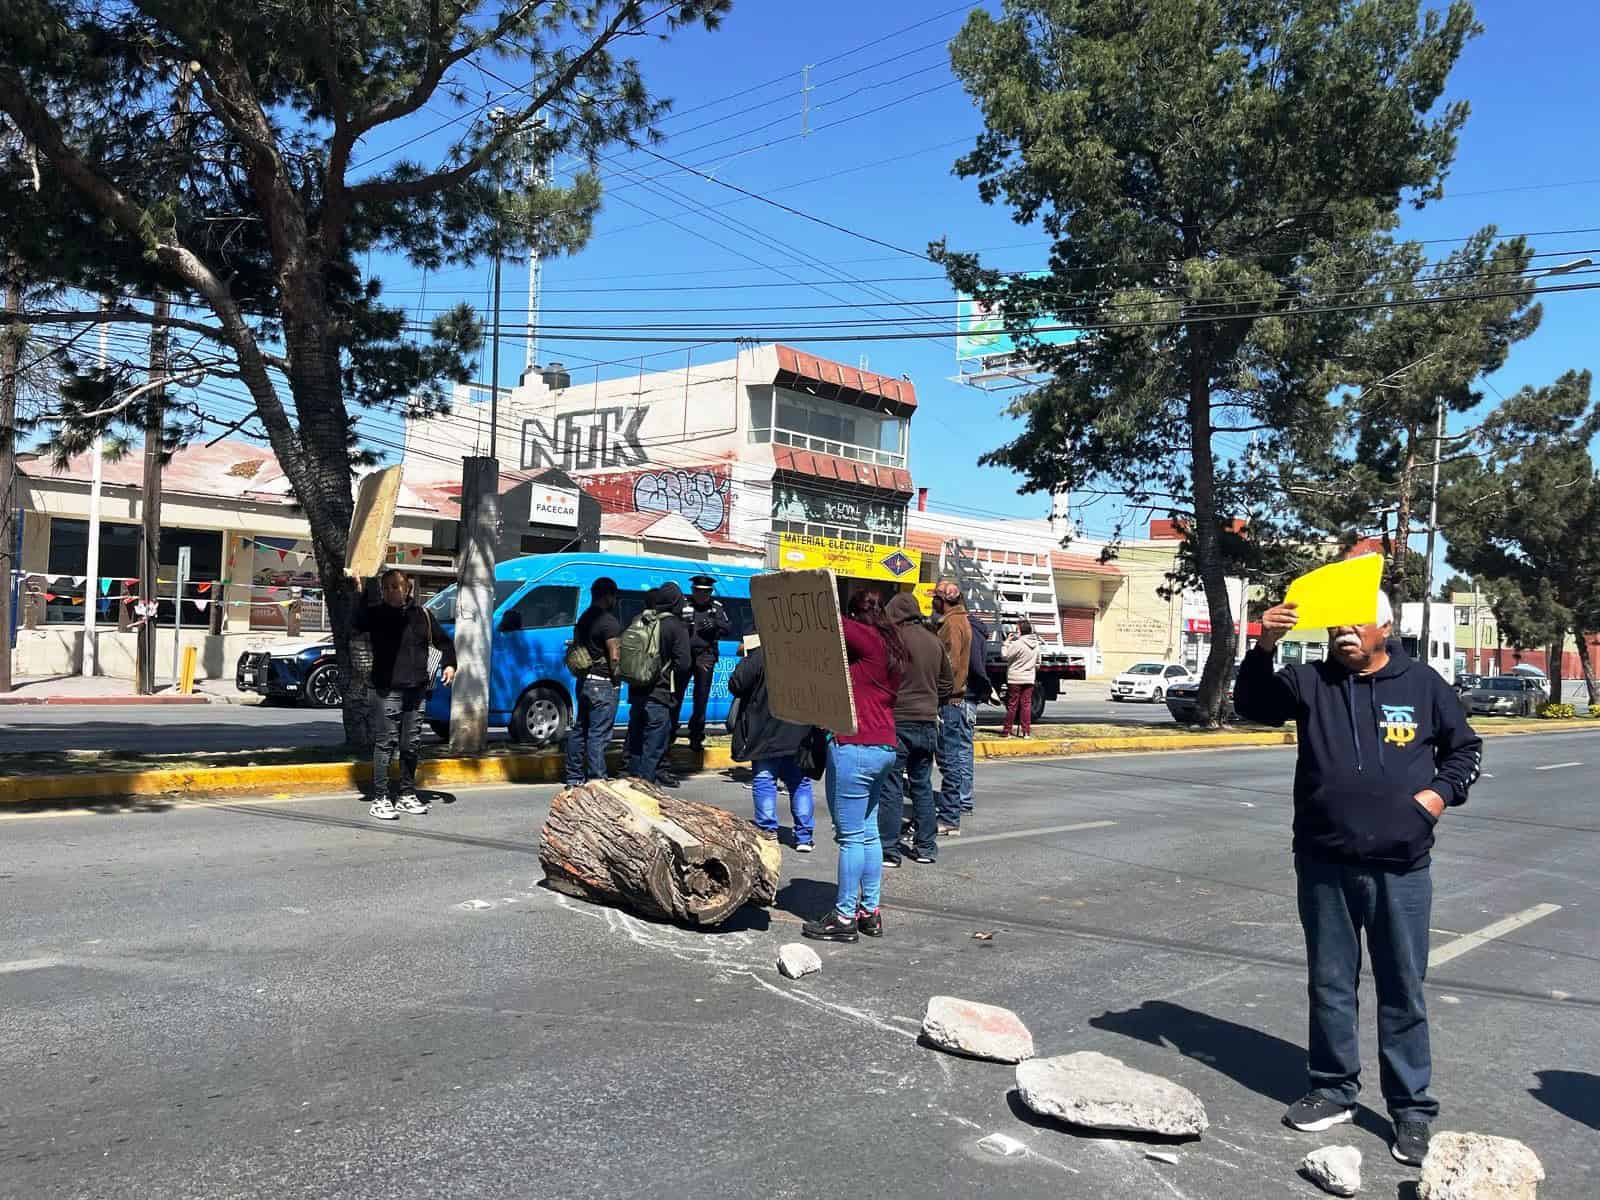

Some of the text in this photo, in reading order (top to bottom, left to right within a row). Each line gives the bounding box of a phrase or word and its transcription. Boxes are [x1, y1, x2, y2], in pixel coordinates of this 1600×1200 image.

[536, 503, 575, 515] FACECAR
[784, 533, 875, 553] MATERIAL ELECTRICO
